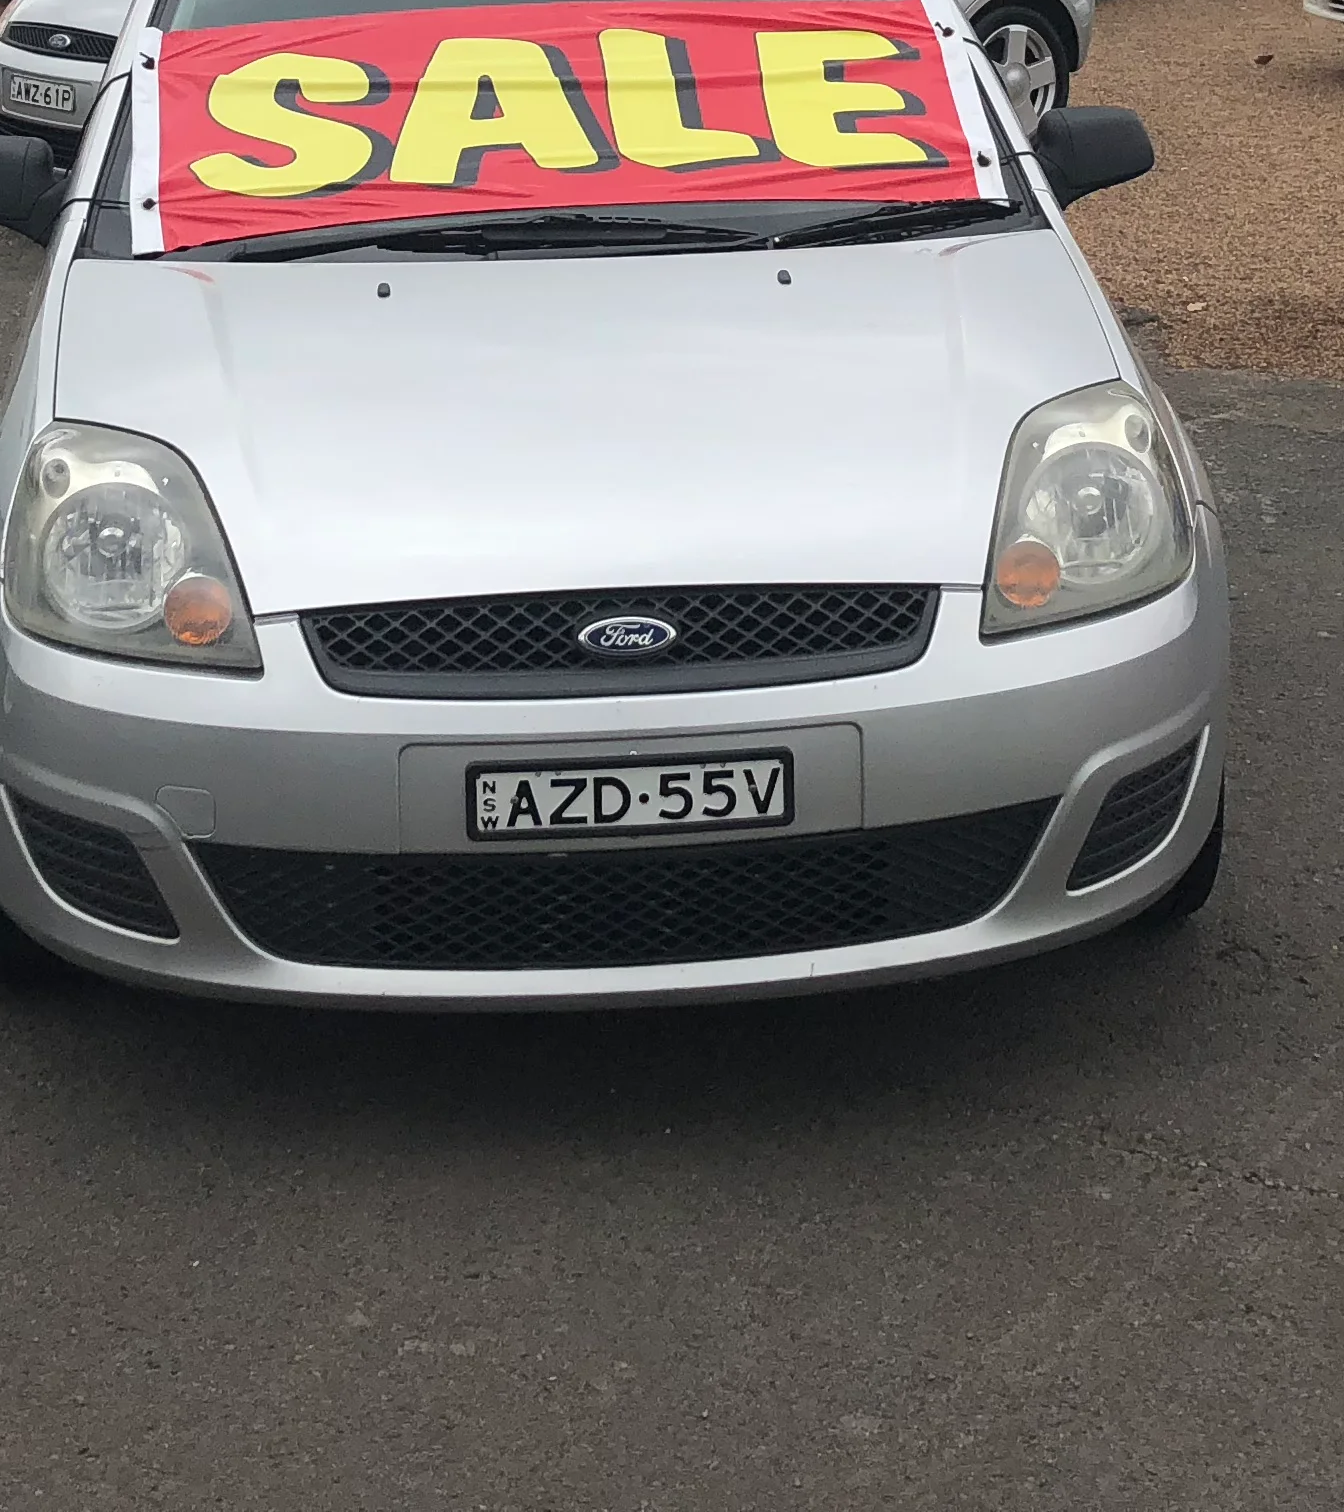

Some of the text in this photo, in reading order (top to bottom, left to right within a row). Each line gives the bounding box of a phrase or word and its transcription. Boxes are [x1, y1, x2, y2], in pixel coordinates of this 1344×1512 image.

[189, 28, 946, 198] SALE
[600, 623, 654, 647] Ford
[481, 780, 499, 829] NSW
